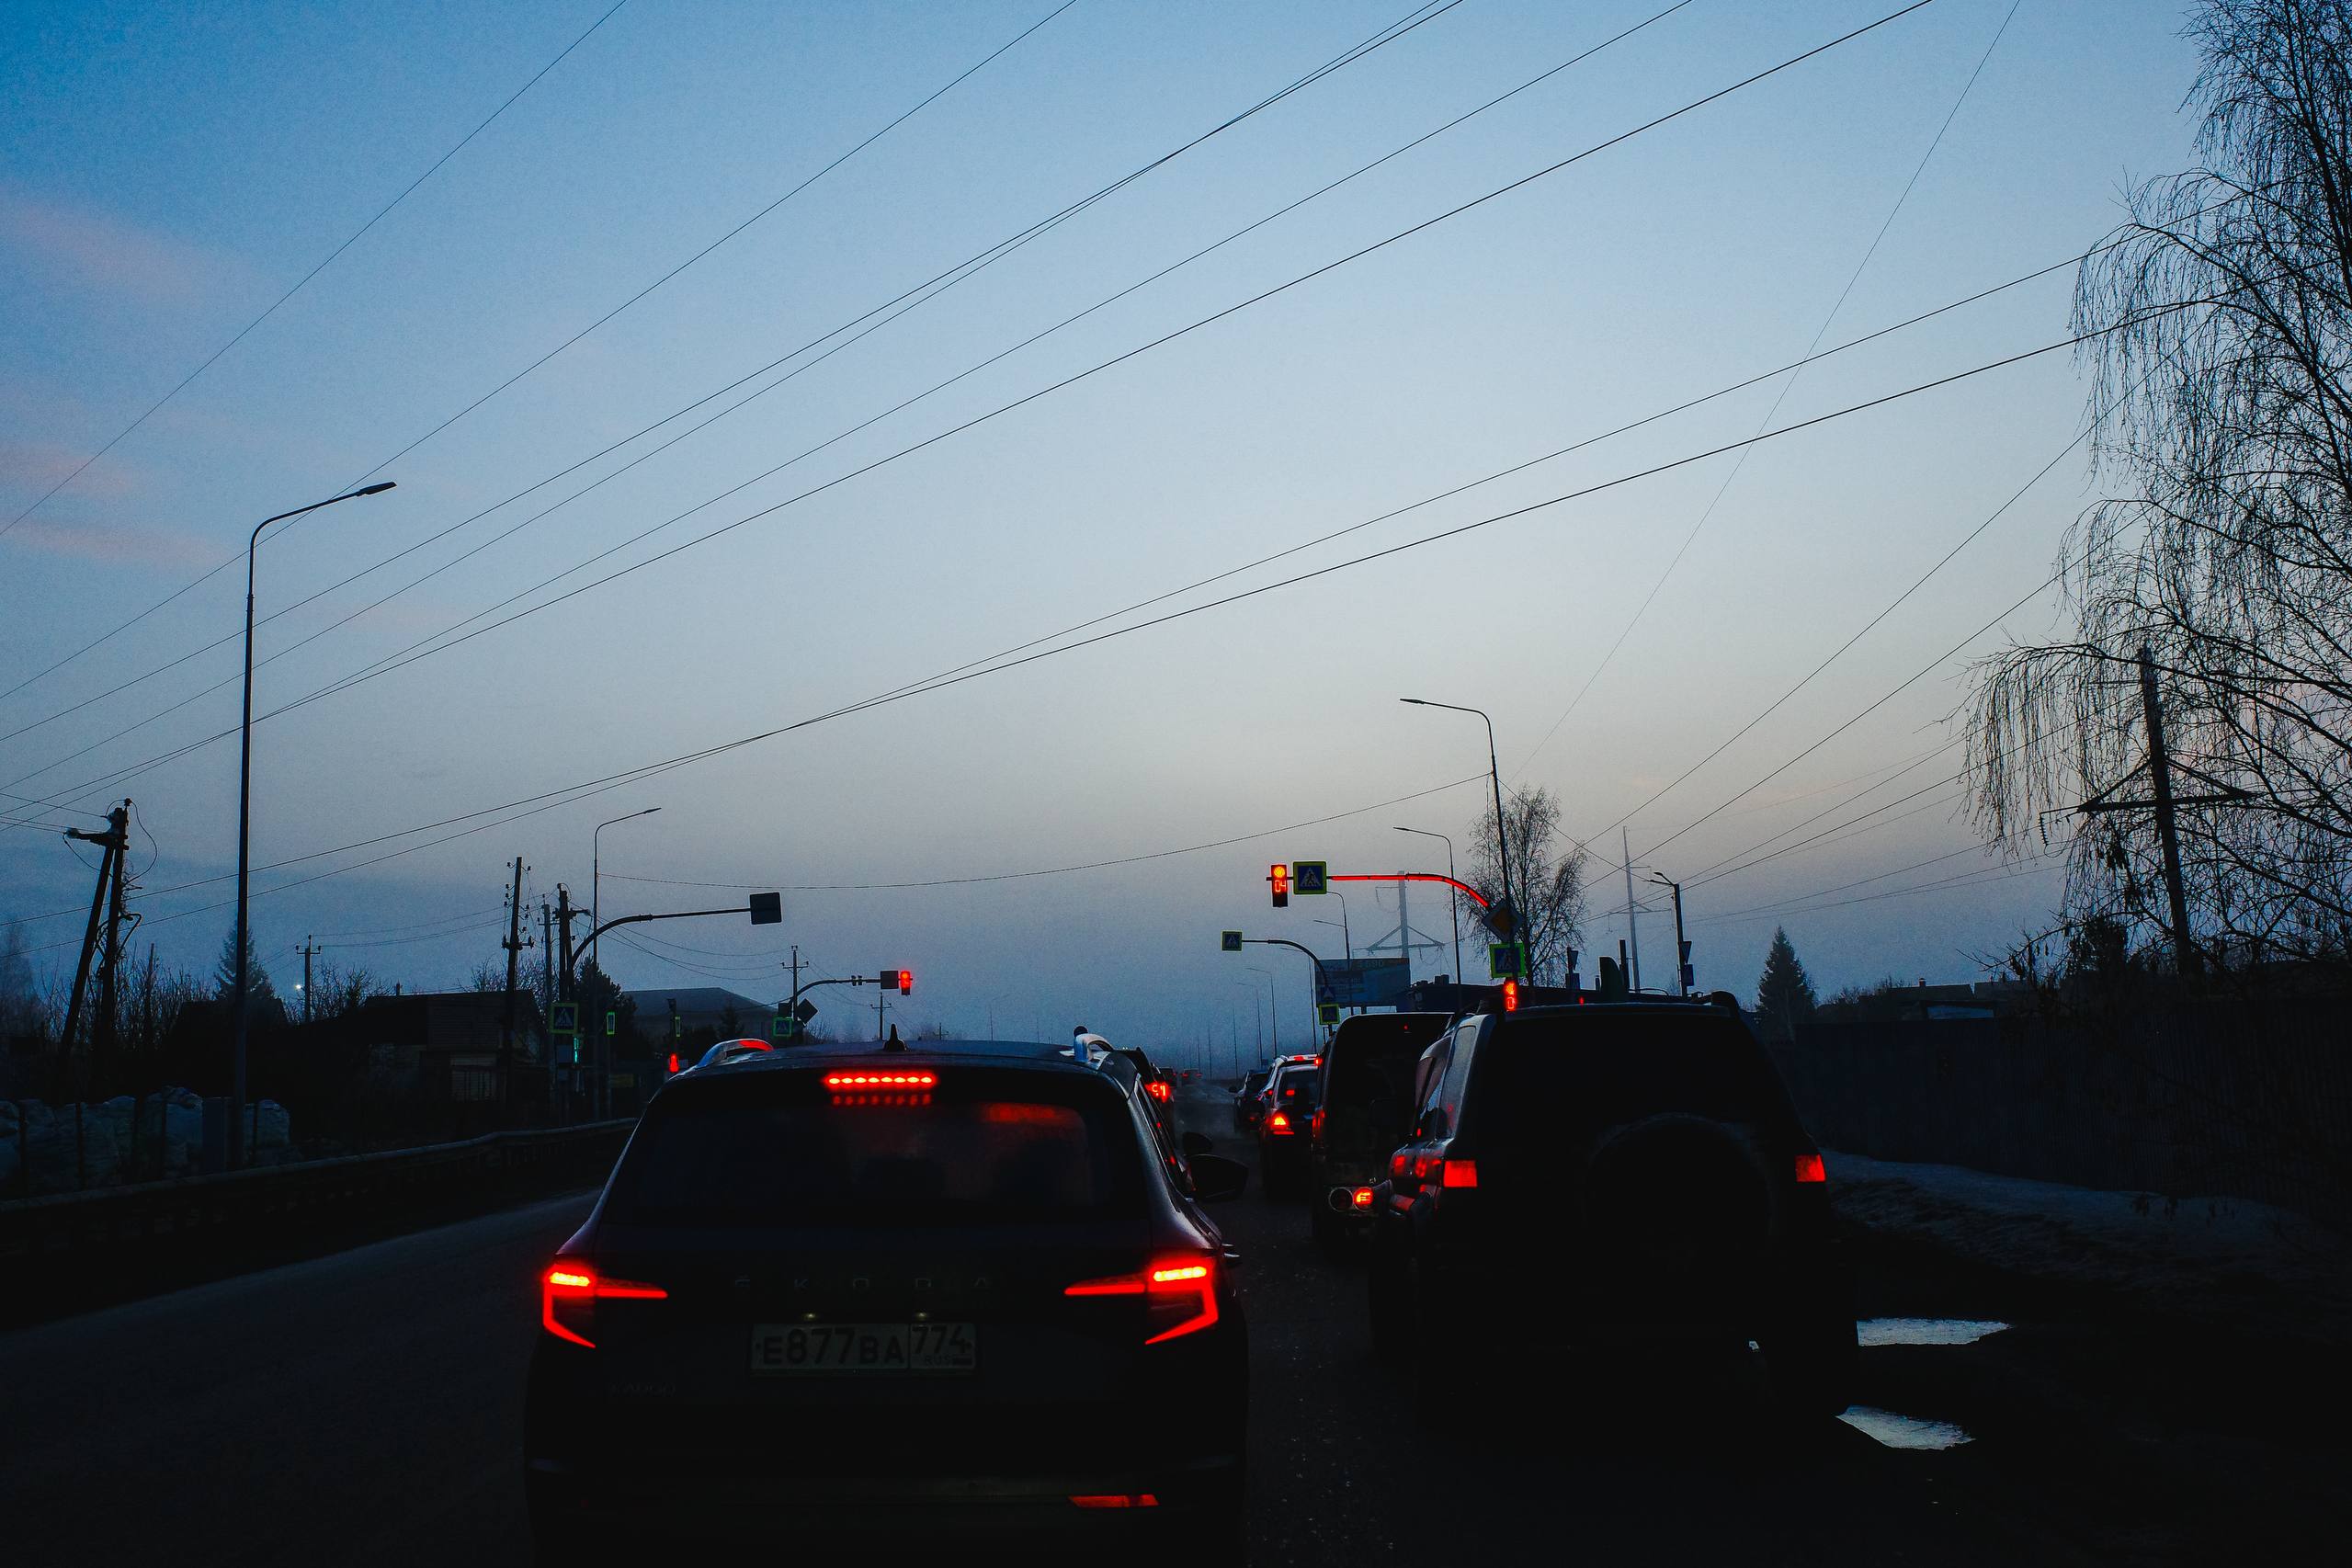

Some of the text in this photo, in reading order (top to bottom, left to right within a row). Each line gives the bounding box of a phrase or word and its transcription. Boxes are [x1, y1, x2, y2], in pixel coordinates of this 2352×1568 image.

[1274, 880, 1287, 893] 04
[912, 1324, 967, 1355] 774
[925, 1354, 952, 1366] RUS
